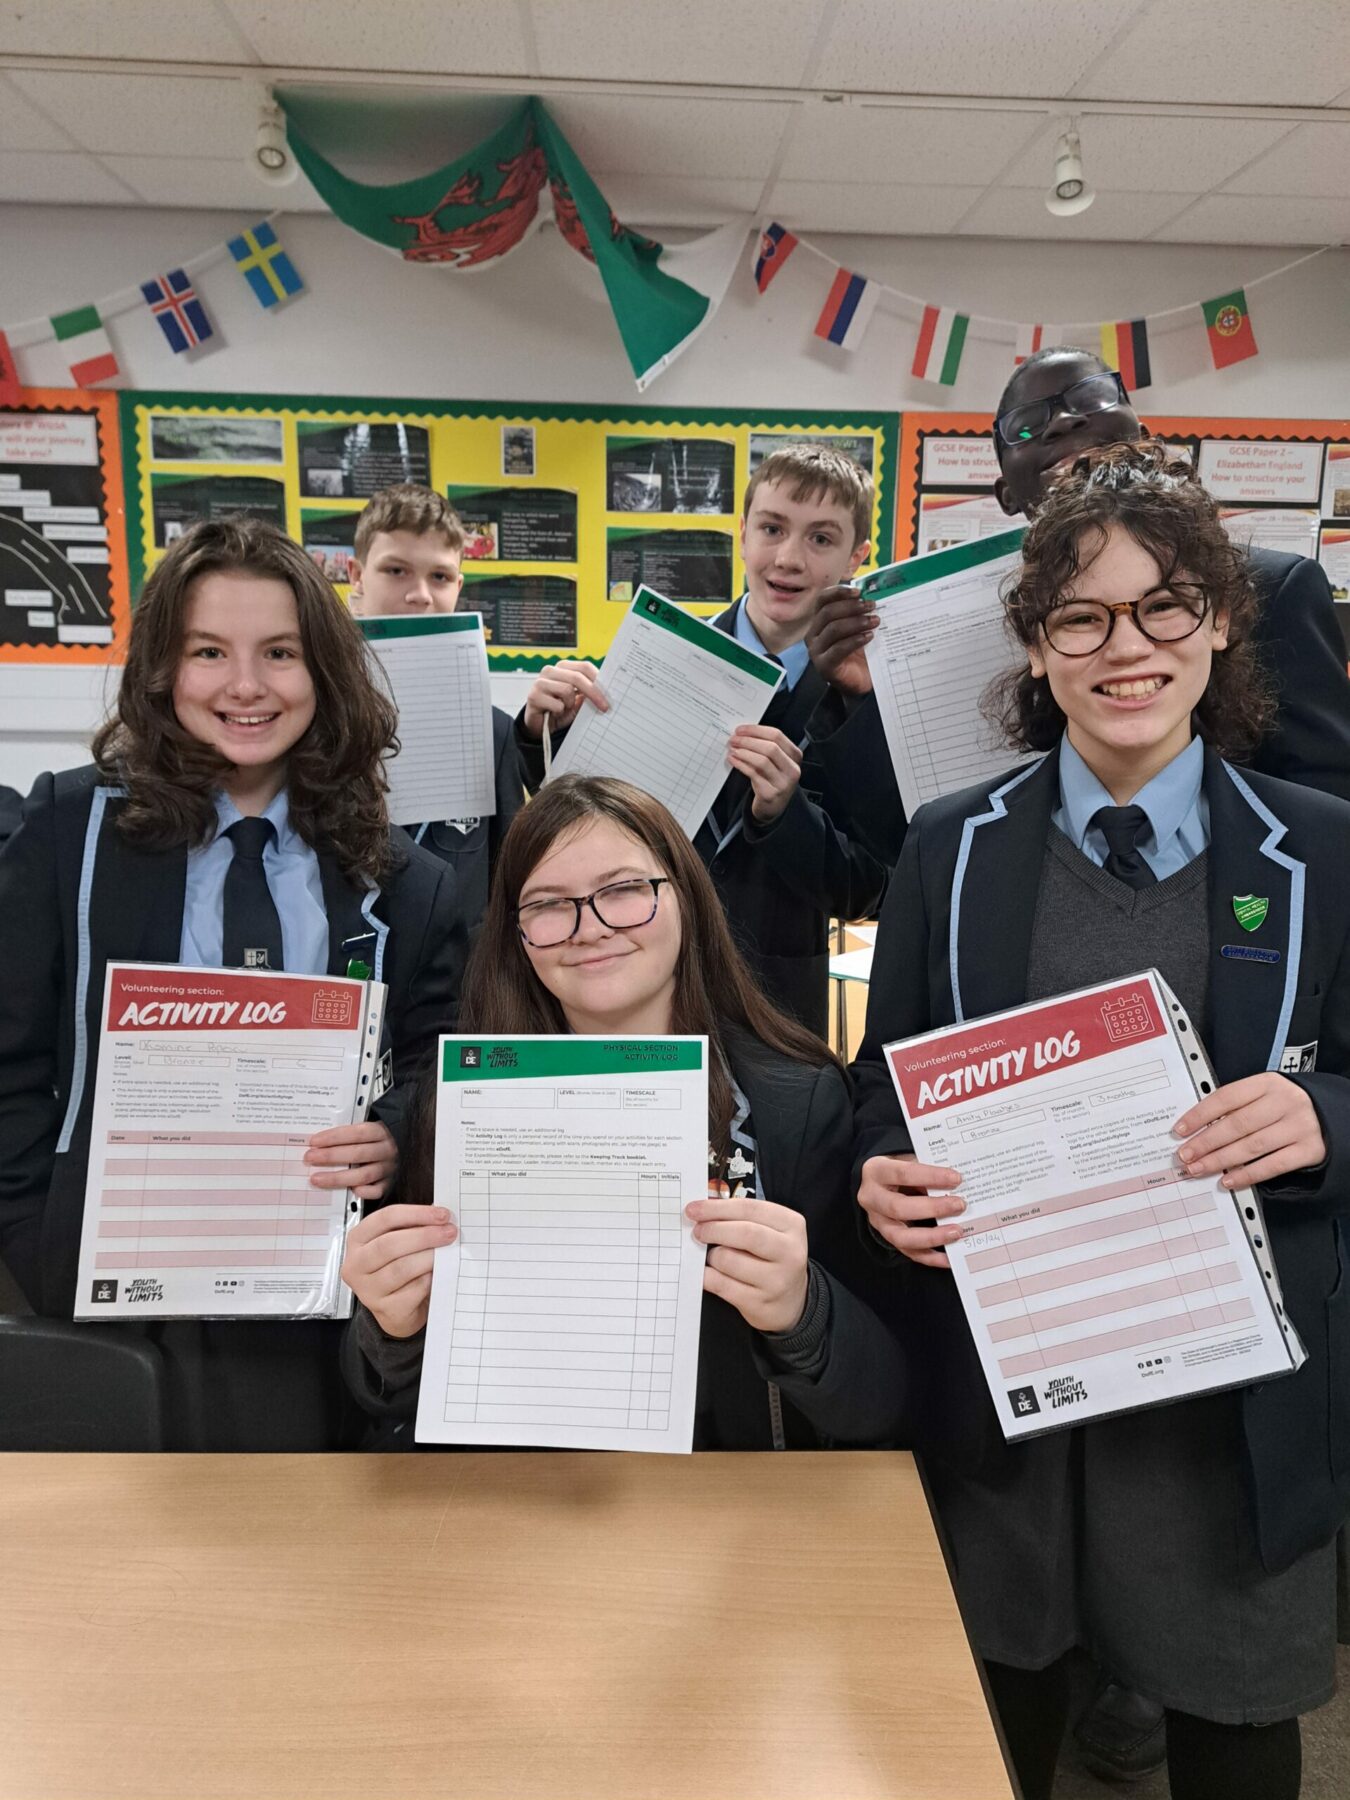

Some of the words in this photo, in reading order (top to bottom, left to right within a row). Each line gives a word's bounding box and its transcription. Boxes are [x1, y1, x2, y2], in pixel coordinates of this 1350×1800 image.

[933, 443, 956, 453] GCSE
[959, 443, 984, 454] Paper
[986, 444, 992, 453] 2
[1229, 447, 1252, 456] GCSE
[1253, 447, 1278, 457] Paper
[1280, 448, 1286, 456] 2
[938, 458, 958, 466] How
[1217, 459, 1266, 469] Elizabethan
[1268, 461, 1303, 471] England
[1211, 473, 1230, 482] How
[1233, 474, 1242, 482] to
[1244, 474, 1284, 482] structure
[1287, 476, 1306, 486] your
[1240, 488, 1276, 496] answers
[120, 983, 185, 997] Volunteering
[187, 987, 225, 996] section:
[118, 1001, 240, 1026] ACTIVITY
[239, 1001, 287, 1025] LOG
[644, 1045, 679, 1053] SECTION
[487, 1052, 518, 1061] WITHOUT
[625, 1053, 660, 1061] ACTIVITY
[904, 1049, 967, 1073] Volunteering
[968, 1037, 1007, 1055] section:
[490, 1059, 519, 1068] LIMITS
[917, 1046, 1028, 1110] ACTIVITY
[1032, 1030, 1081, 1070] LOG
[1096, 1095, 1106, 1103] 3
[1051, 1099, 1083, 1112] Timescale:
[923, 1124, 943, 1133] Name:
[928, 1138, 945, 1147] Level:
[612, 1153, 625, 1161] Track
[1147, 1176, 1166, 1185] Hours
[1001, 1214, 1018, 1223] What
[1019, 1211, 1031, 1220] you
[1030, 1207, 1041, 1215] did
[132, 1279, 157, 1287] YOUTH
[125, 1284, 163, 1294] WITHOUT
[128, 1292, 163, 1302] LIMITS
[1048, 1375, 1075, 1390] YOUTH
[1044, 1382, 1084, 1400] WITHOUT
[1051, 1391, 1089, 1409] LIMITS
